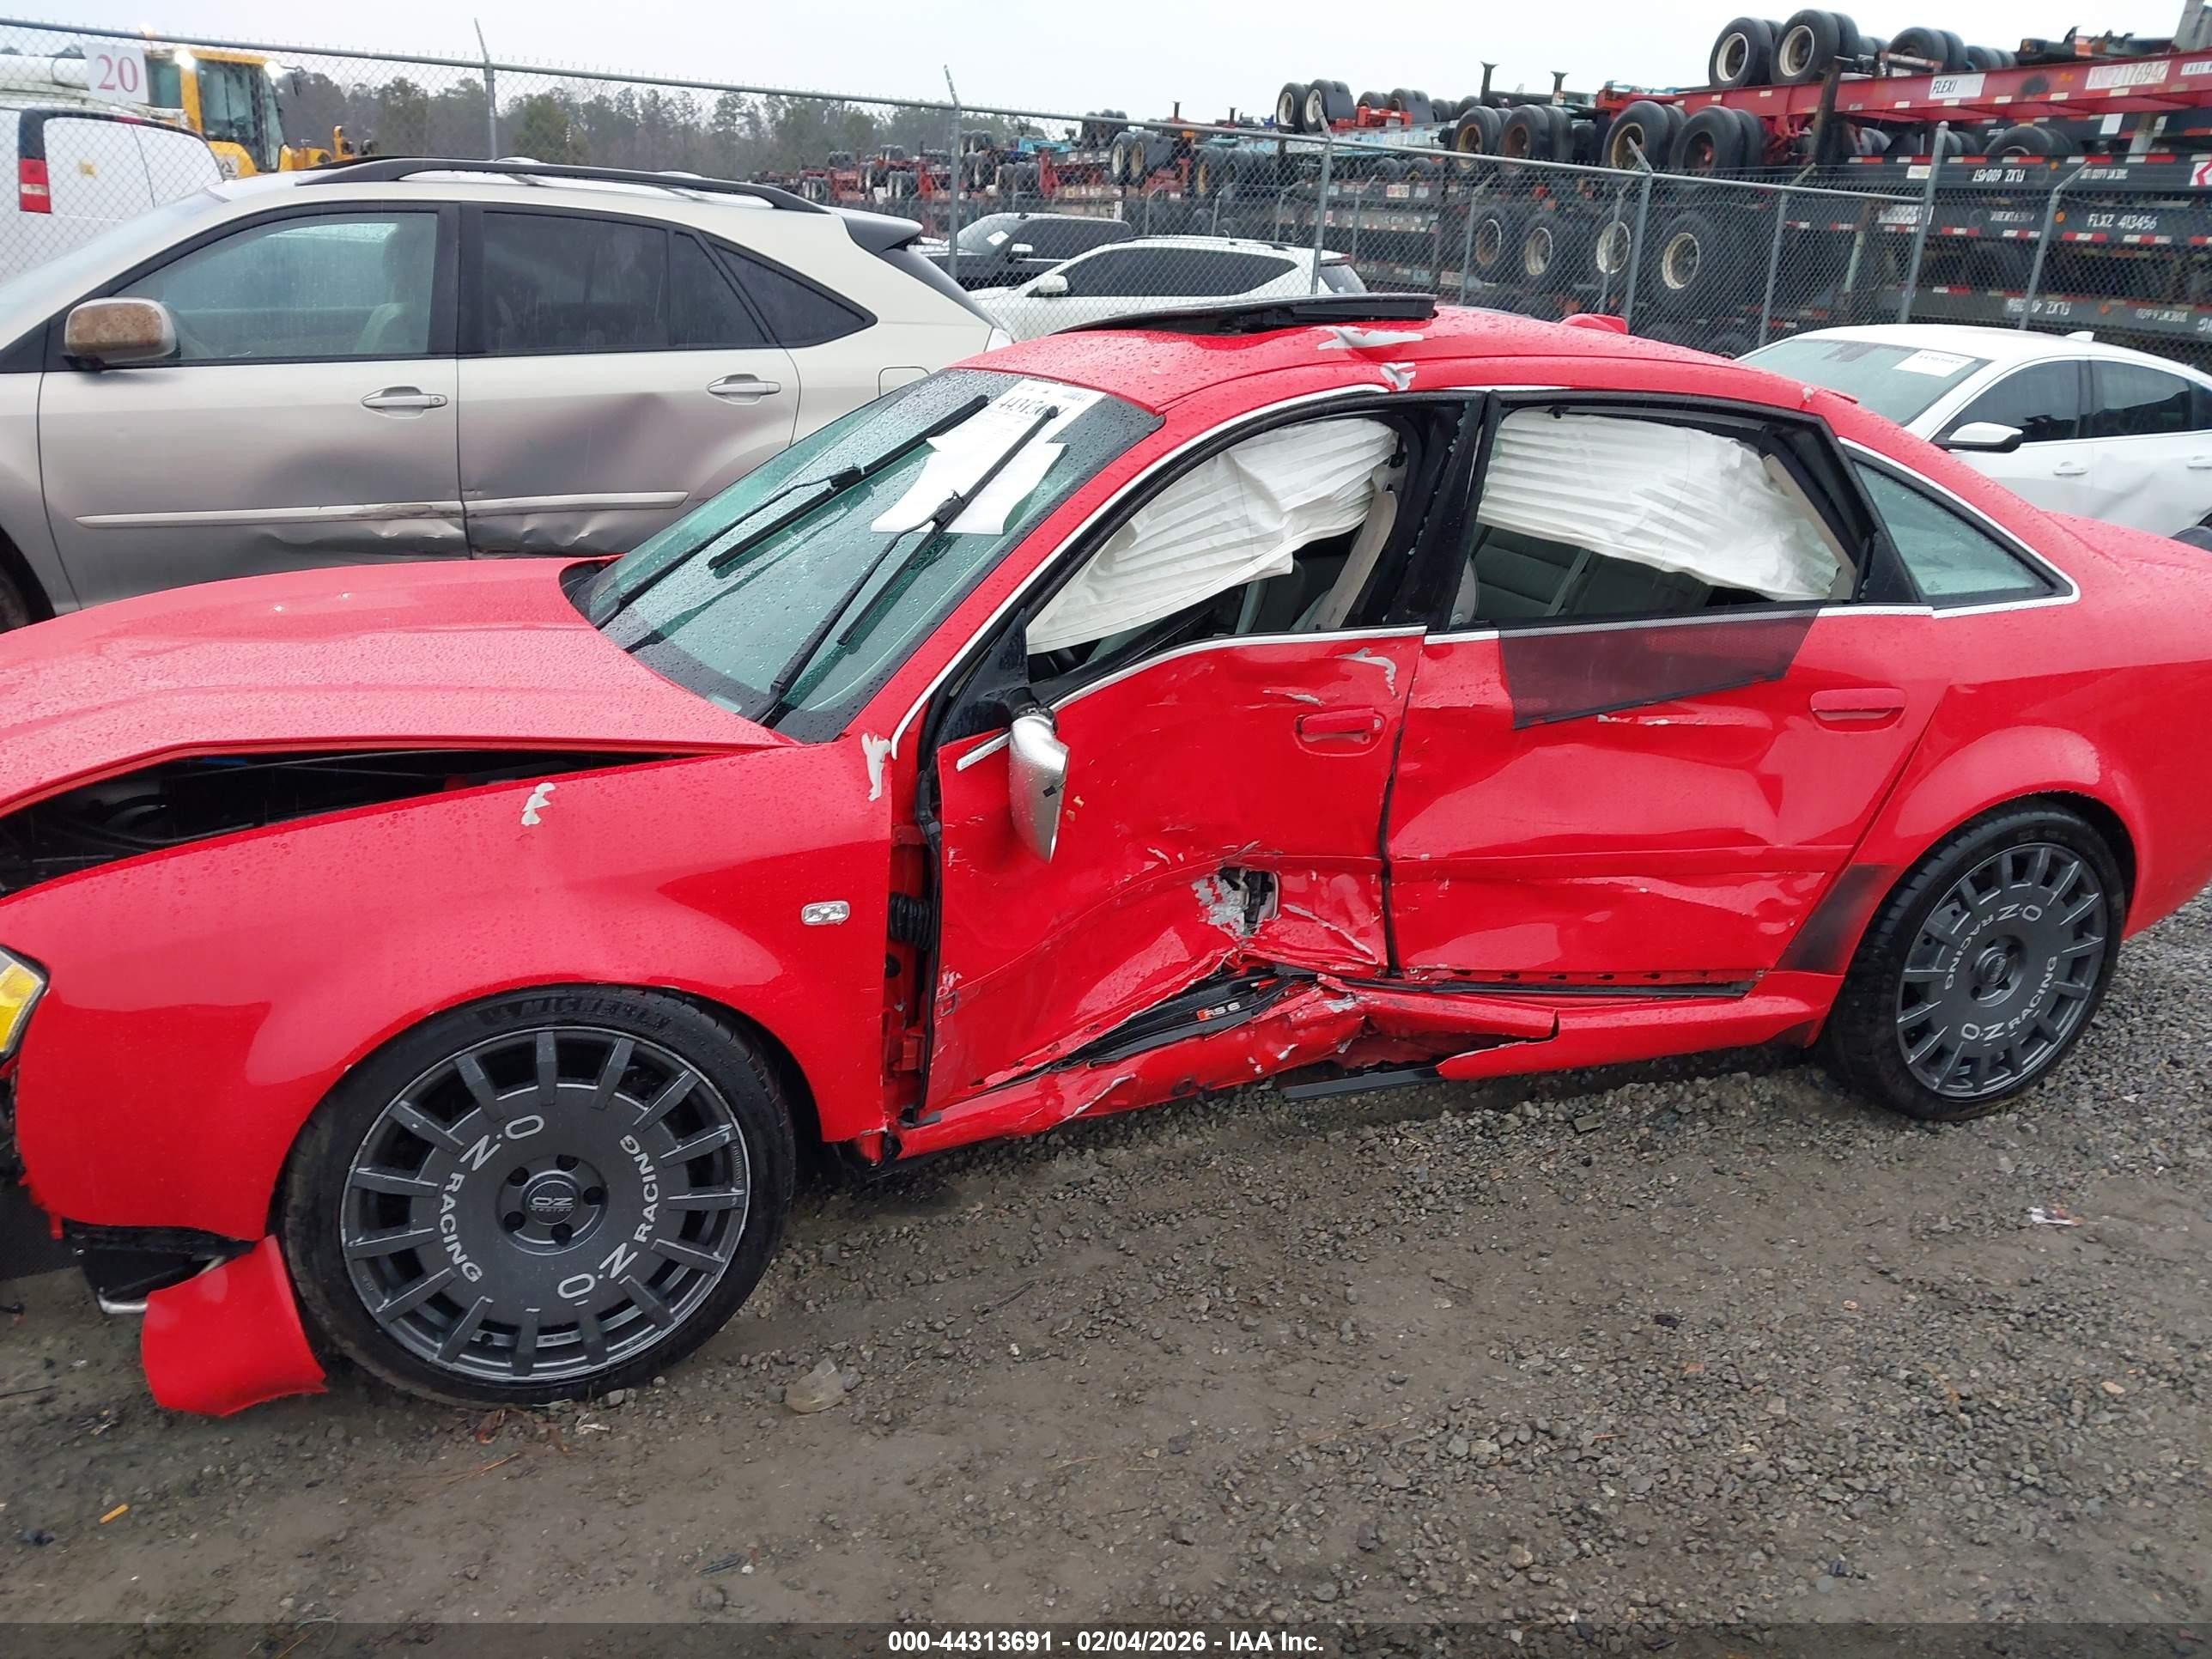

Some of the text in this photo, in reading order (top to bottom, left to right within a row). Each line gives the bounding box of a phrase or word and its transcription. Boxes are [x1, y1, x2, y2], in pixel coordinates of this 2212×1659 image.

[96, 54, 137, 93] 20
[2087, 213, 2116, 228] FLXZ
[1944, 914, 1994, 990] RACING
[2008, 956, 2058, 1030] RACING
[618, 1133, 659, 1243] RACING
[439, 1171, 483, 1283] RACING
